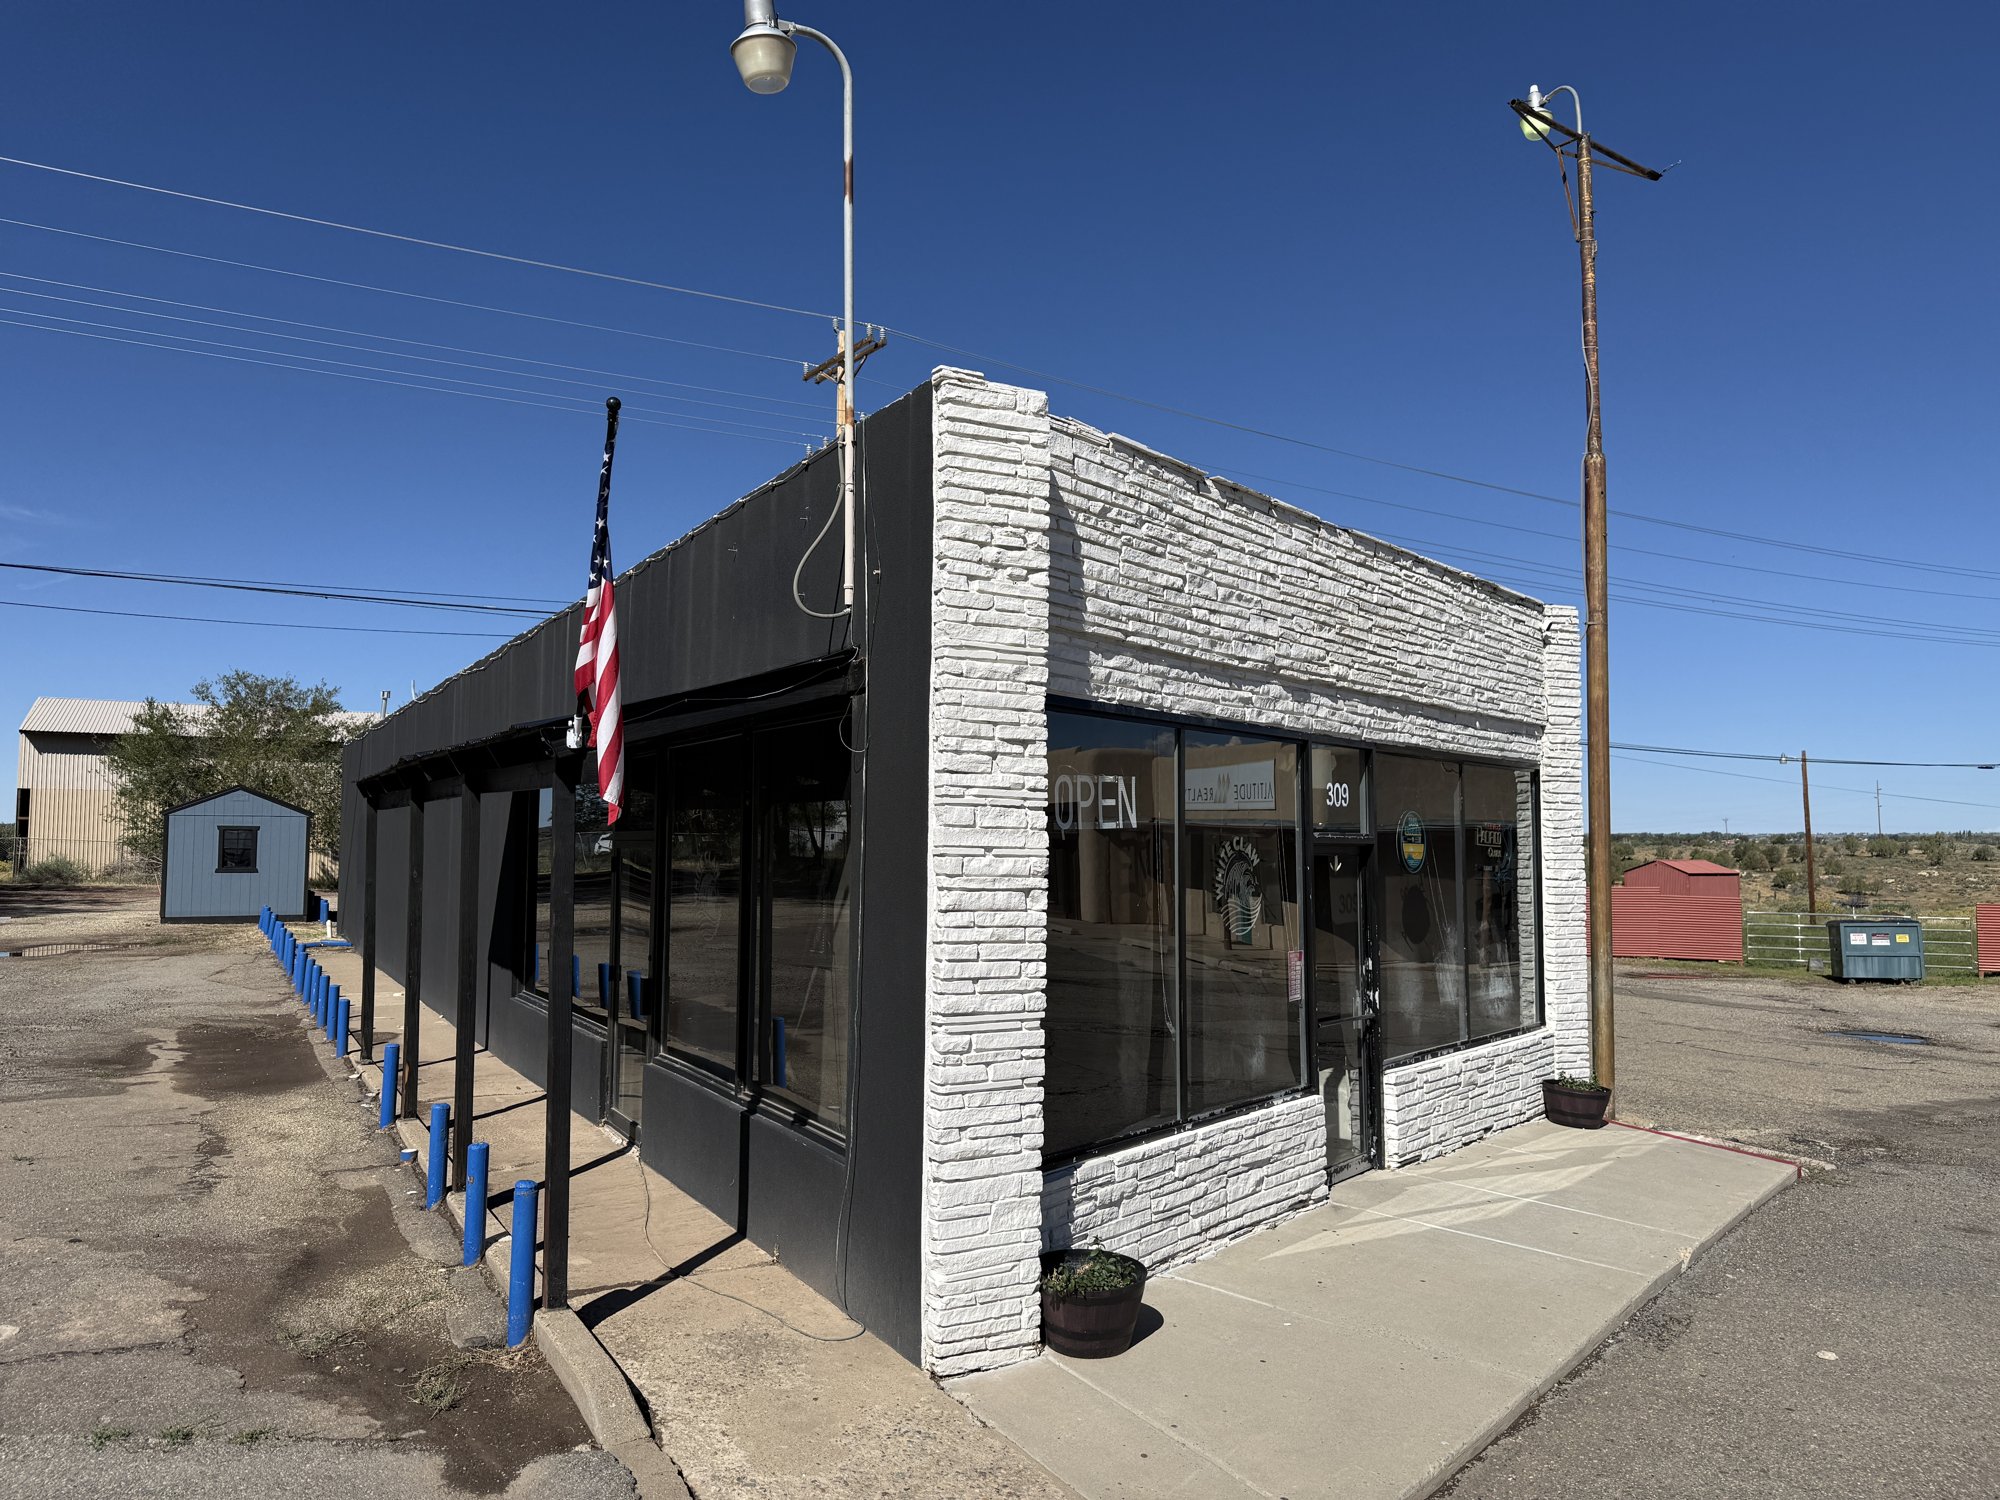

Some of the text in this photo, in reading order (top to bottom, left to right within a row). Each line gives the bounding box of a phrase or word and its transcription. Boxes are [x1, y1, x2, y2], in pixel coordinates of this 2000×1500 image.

[1055, 774, 1138, 830] OPEN
[1326, 782, 1349, 807] 309
[1215, 836, 1260, 900] WHITE CLAW
